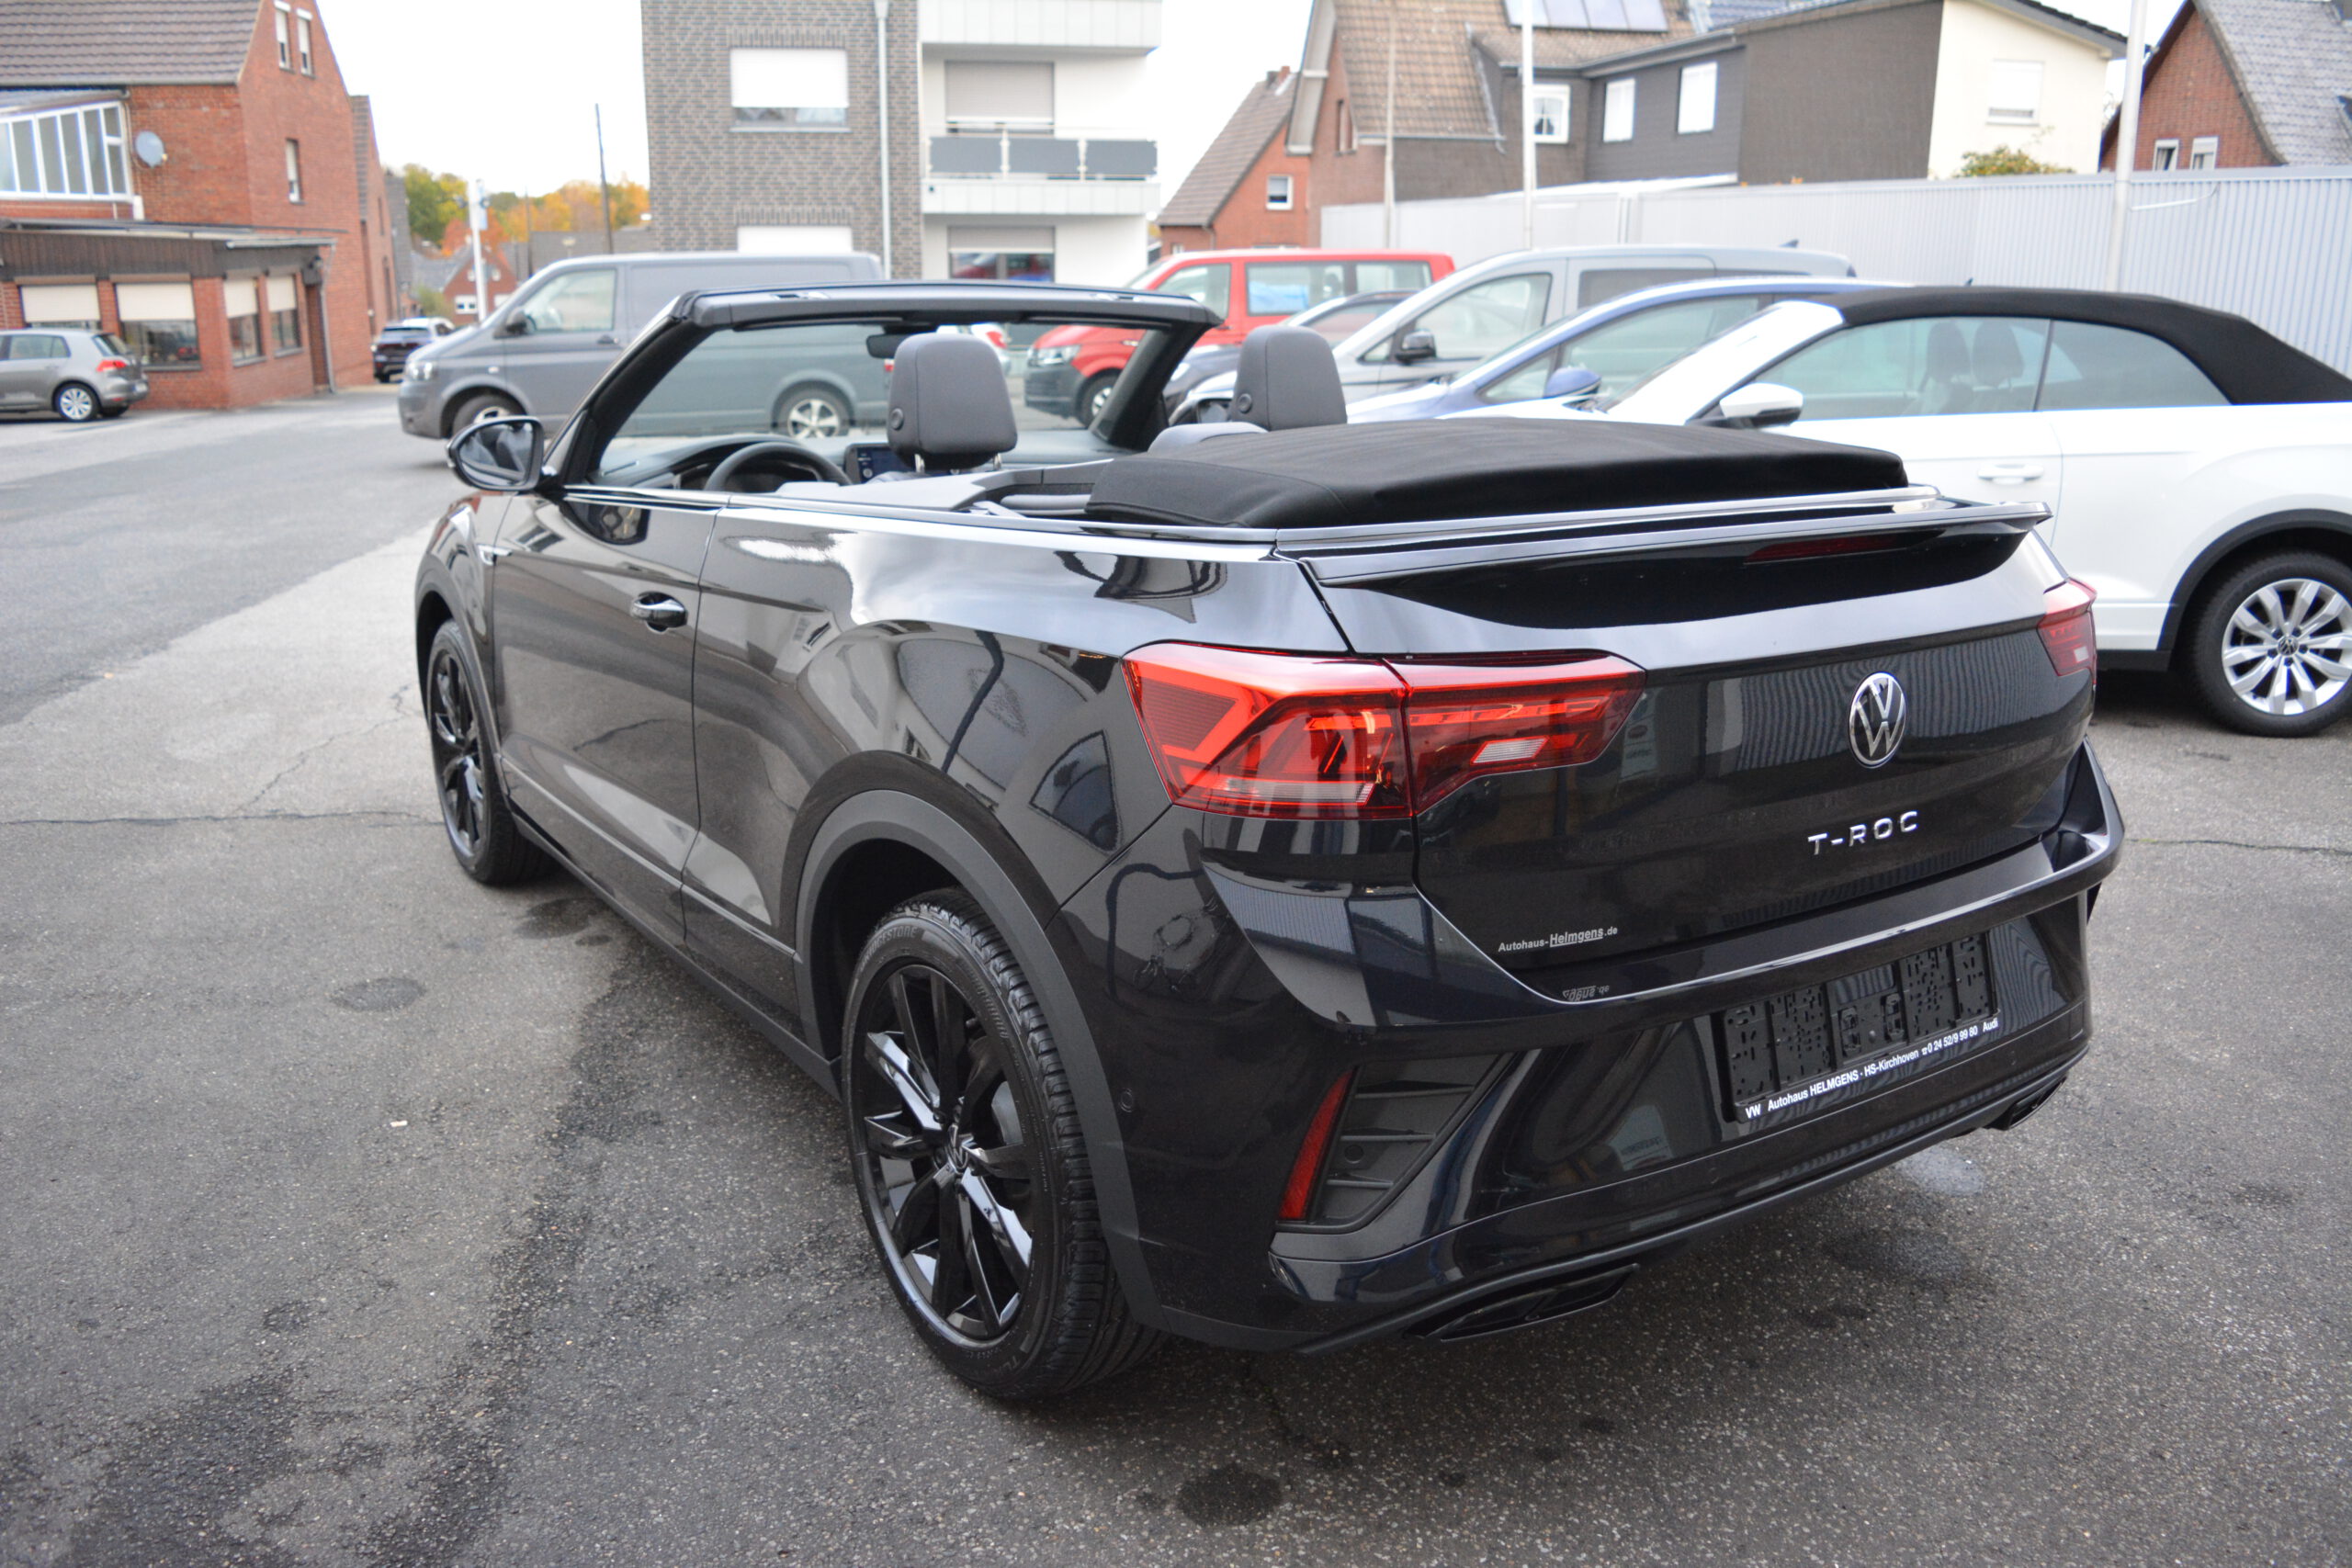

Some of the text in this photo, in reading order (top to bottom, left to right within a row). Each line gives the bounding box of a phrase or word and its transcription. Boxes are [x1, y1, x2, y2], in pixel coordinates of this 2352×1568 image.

[1849, 673, 1906, 767] VW
[1807, 810, 1918, 855] T-ROC
[1745, 1103, 1761, 1119] VW
[1767, 1089, 1809, 1111] Autohaus
[1809, 1069, 1860, 1097] HELMGENS
[1863, 1049, 1919, 1077] HS-Kirchhoven
[1982, 1017, 1999, 1032] Audi
